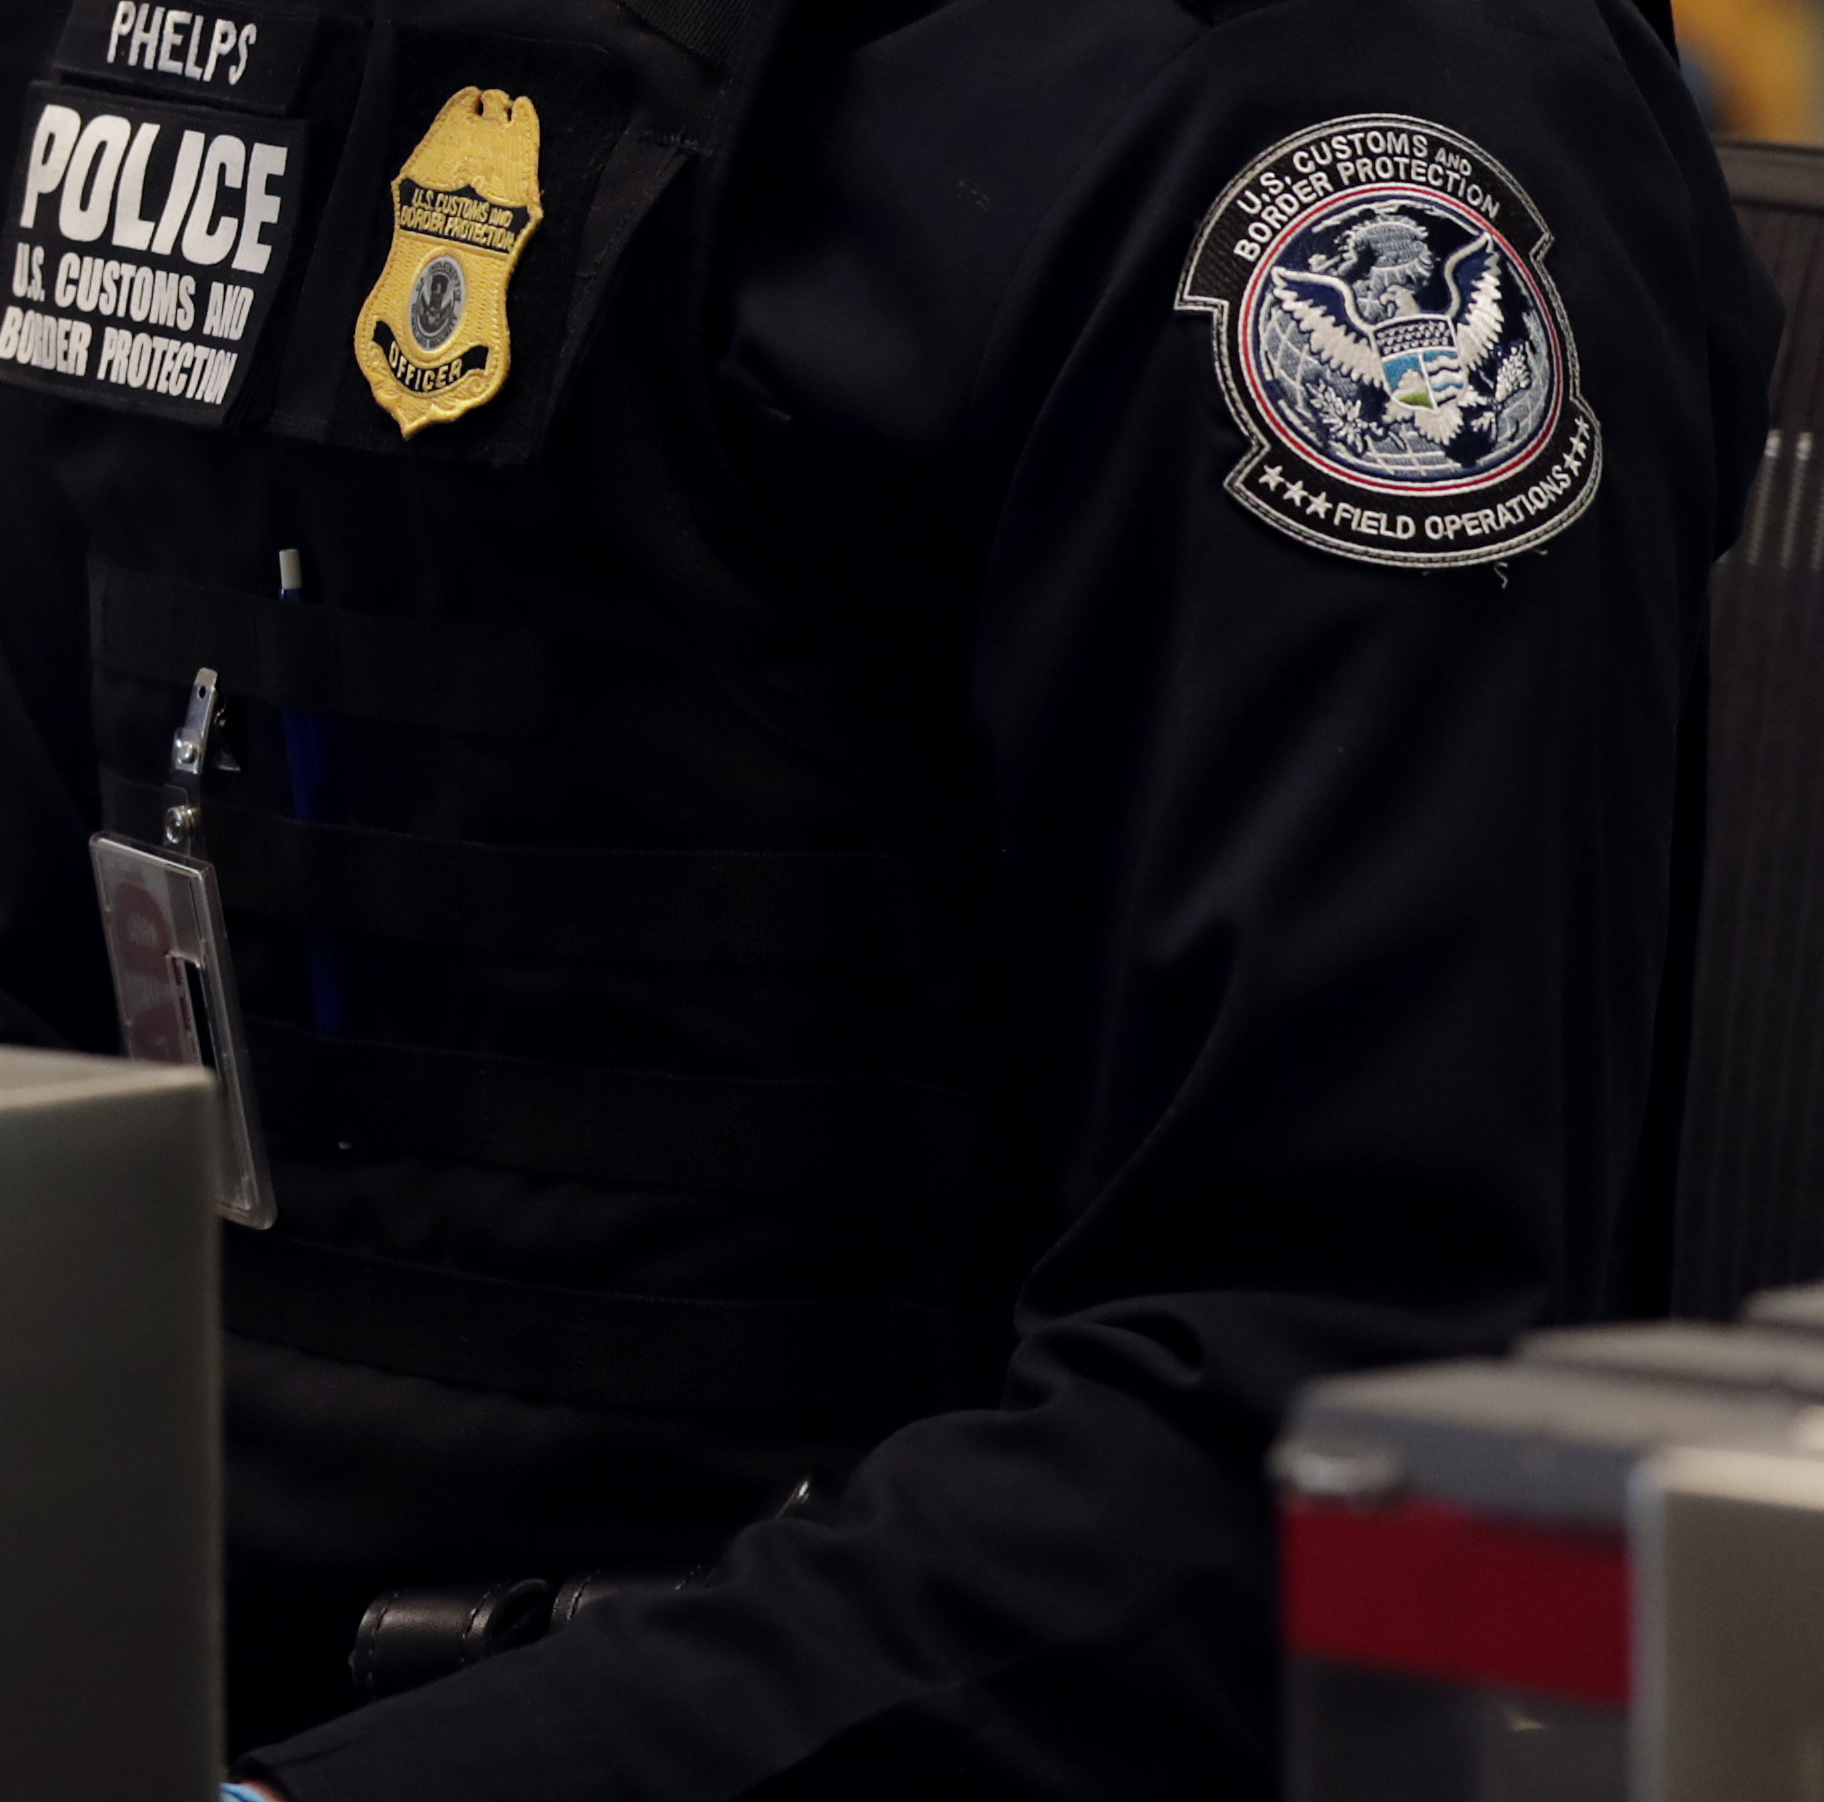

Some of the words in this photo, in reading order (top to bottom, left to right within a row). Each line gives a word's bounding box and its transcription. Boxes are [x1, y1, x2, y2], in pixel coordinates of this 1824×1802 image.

[107, 0, 257, 85] PHELPS
[19, 104, 288, 274] POLICE
[1293, 130, 1429, 174] CUSTOMS
[1435, 147, 1472, 177] AND
[400, 205, 446, 235] BORDER
[444, 217, 515, 251] PROTECTION
[434, 193, 490, 223] CUSTOMS
[1233, 171, 1334, 262] BORDER
[1336, 156, 1501, 219] PROTECTION
[12, 242, 45, 302] U.S.
[55, 252, 196, 331] CUSTOMS
[203, 281, 254, 340] AND
[97, 326, 238, 405] PROTECTION
[388, 340, 463, 391] OFFICER
[1333, 501, 1416, 540] FIELD
[1425, 464, 1572, 540] OPERATIONS
